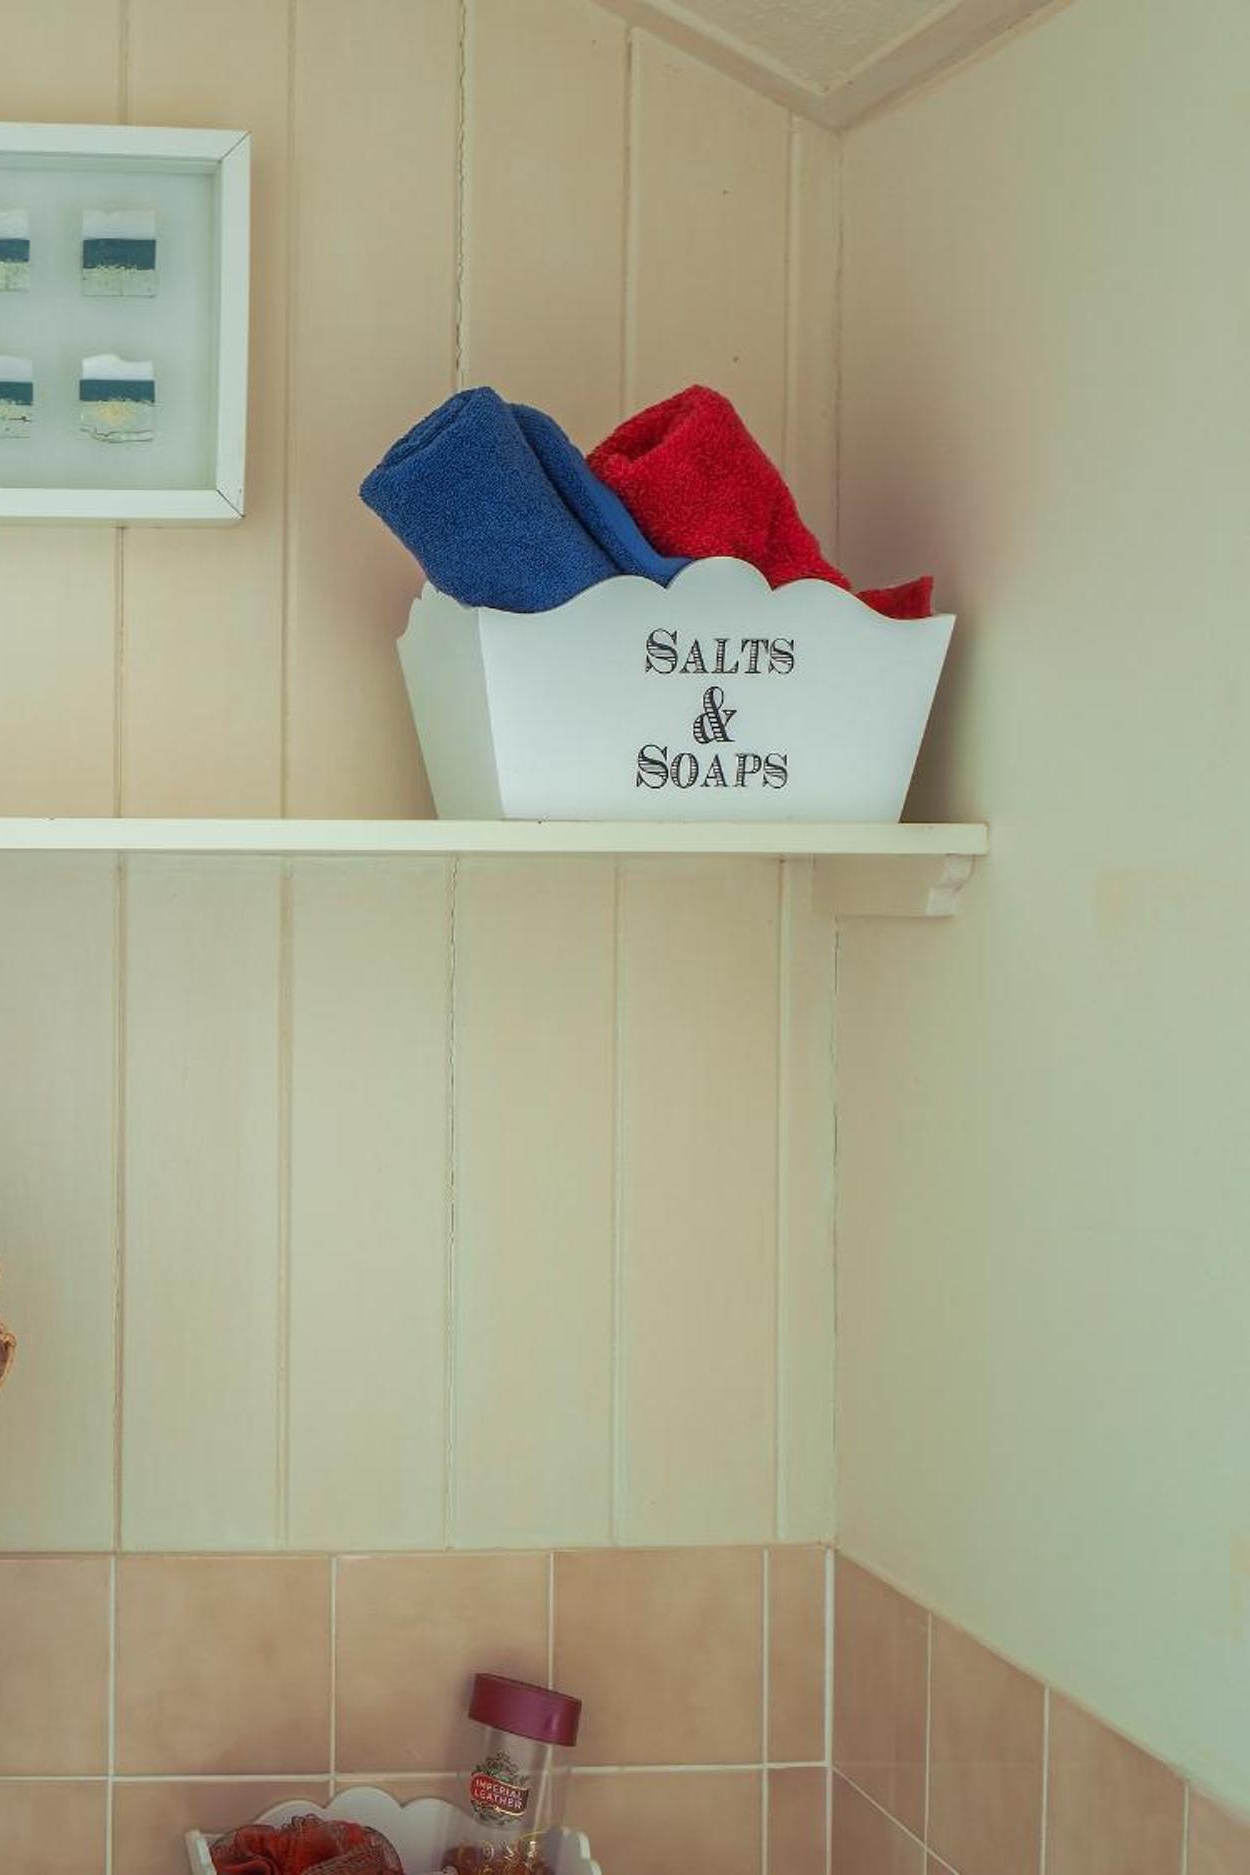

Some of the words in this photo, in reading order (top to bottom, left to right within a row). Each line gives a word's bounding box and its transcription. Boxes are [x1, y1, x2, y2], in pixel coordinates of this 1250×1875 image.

[645, 628, 794, 674] SALTS
[693, 686, 737, 744] &
[636, 744, 788, 789] SOAPS
[474, 1789, 523, 1809] LEATHER
[475, 1779, 522, 1799] IMPERIAL
